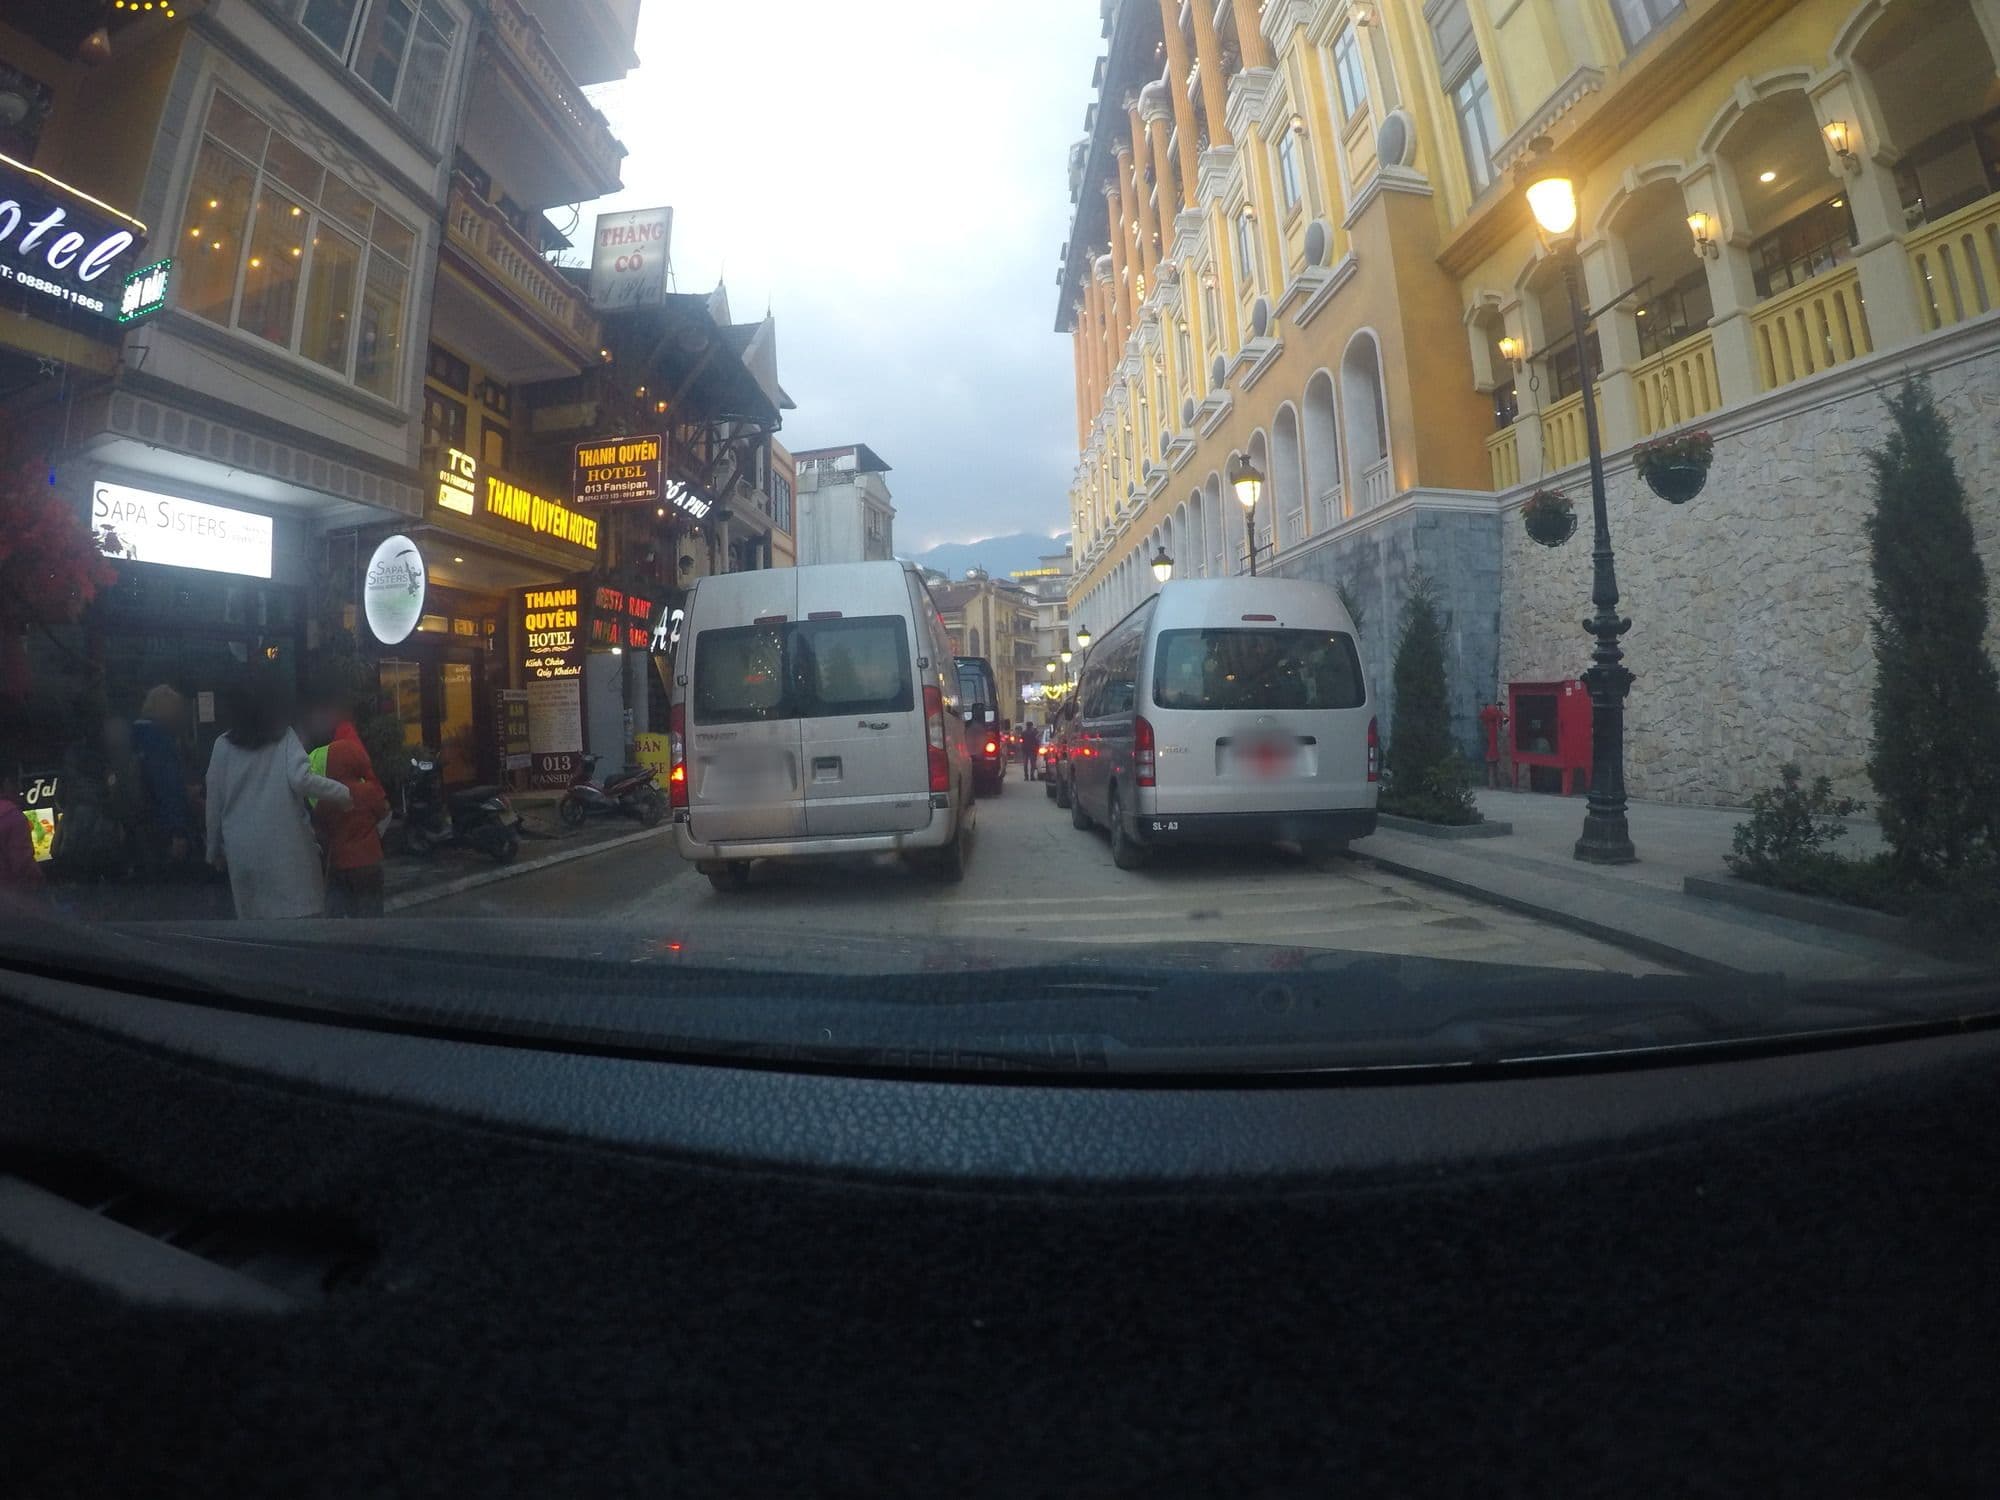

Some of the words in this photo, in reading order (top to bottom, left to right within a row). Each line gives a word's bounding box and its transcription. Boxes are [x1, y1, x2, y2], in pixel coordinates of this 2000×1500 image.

[449, 448, 476, 479] TQ
[579, 447, 616, 467] THANH
[587, 465, 646, 482] HOTEL
[585, 485, 602, 494] 013
[604, 481, 648, 492] Fansipan
[487, 477, 531, 525] THANH
[568, 512, 597, 550] HOTEL
[525, 589, 576, 608] THANH
[526, 608, 577, 631] QUYÊN
[528, 631, 575, 648] HOTEL
[543, 756, 571, 771] 013
